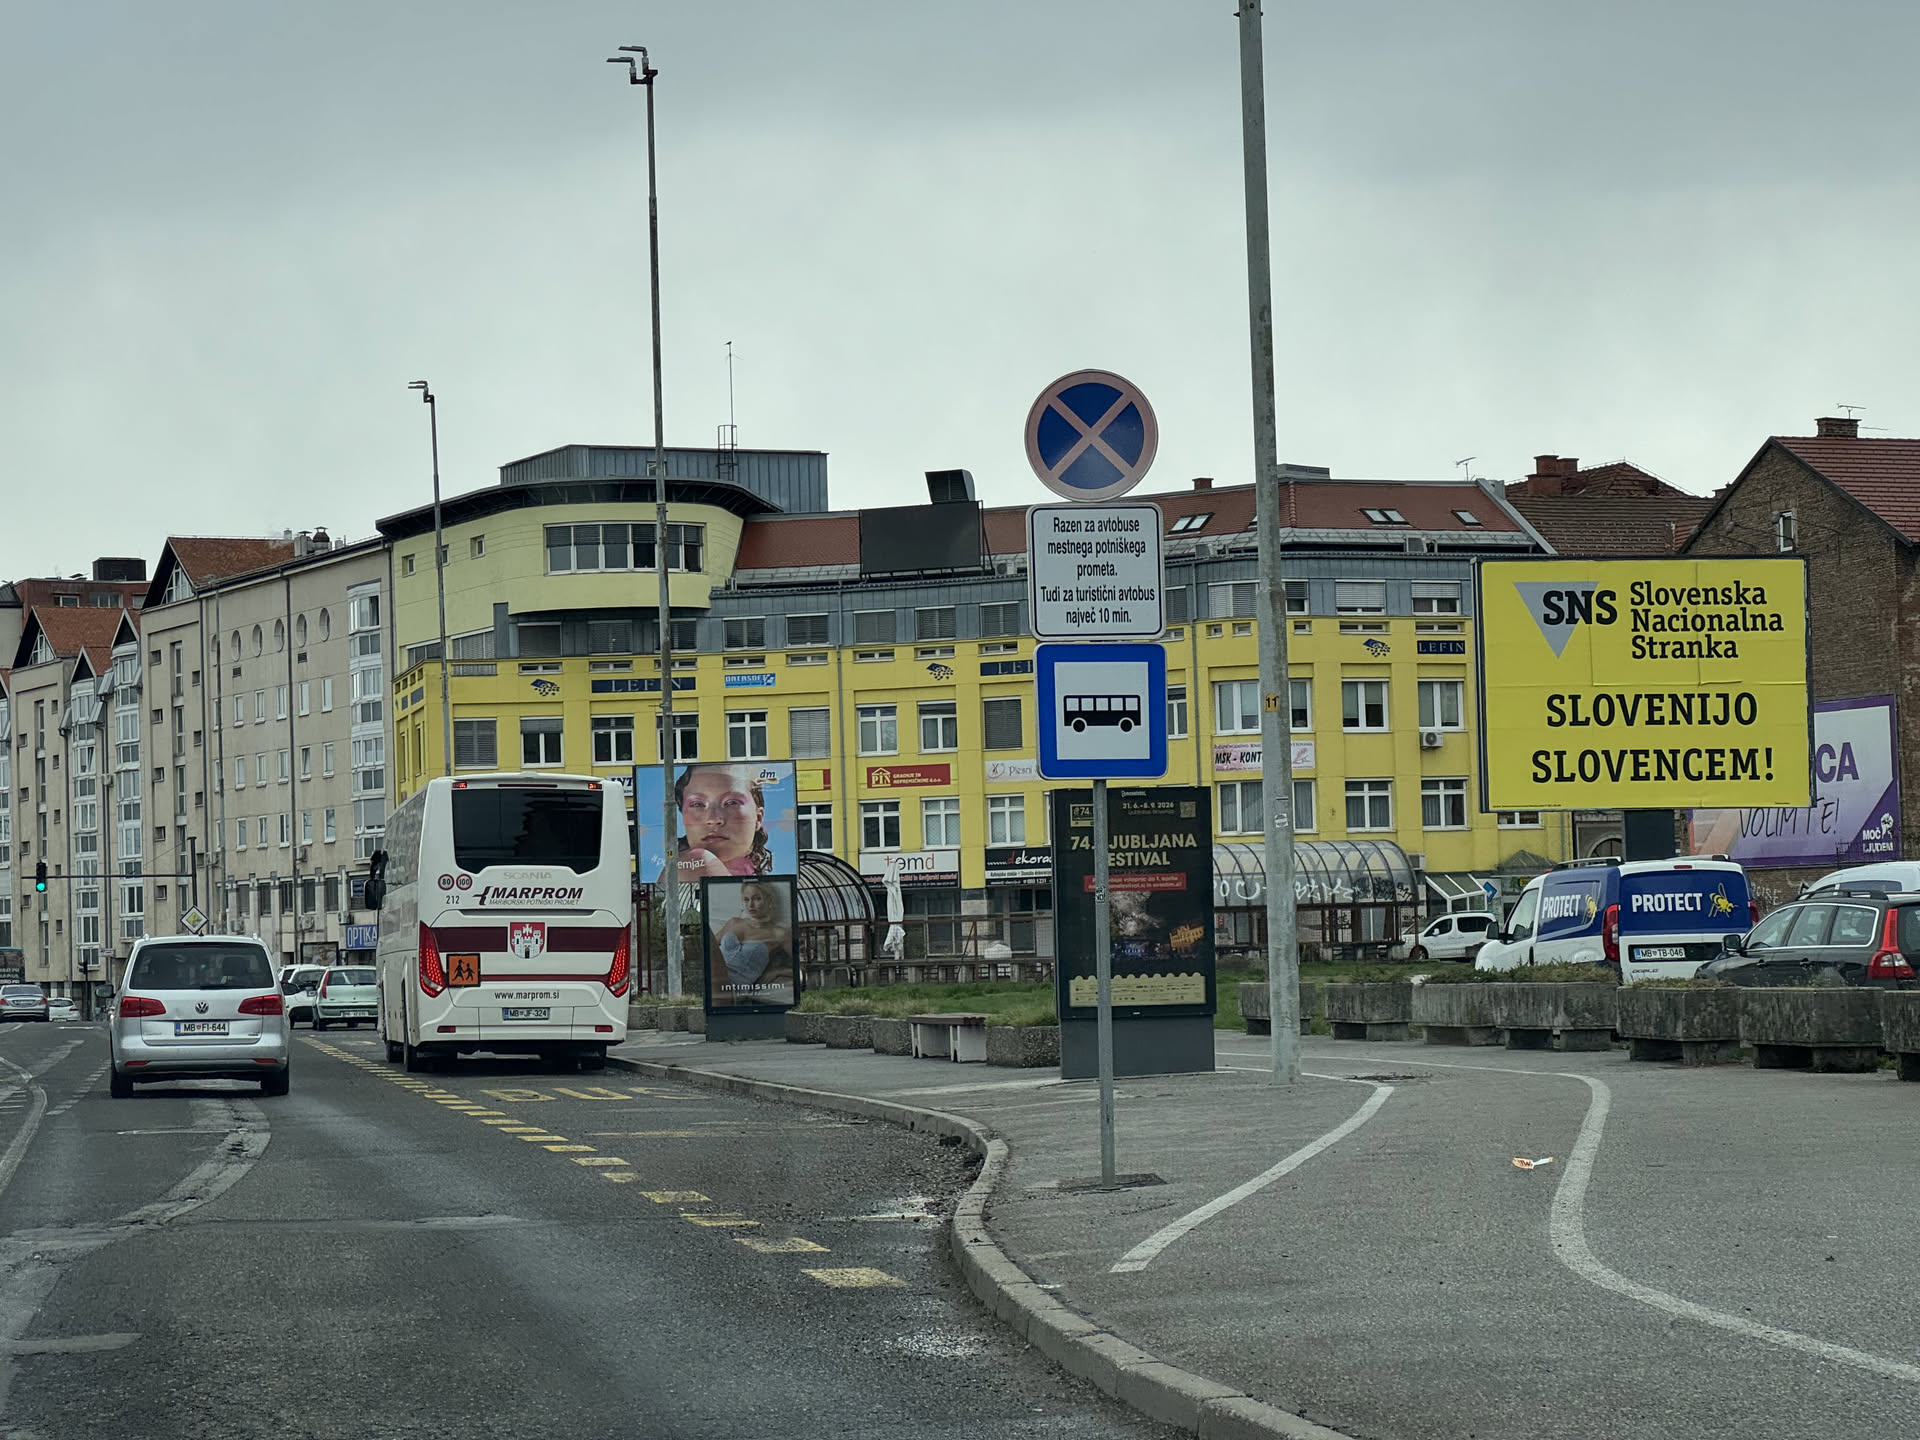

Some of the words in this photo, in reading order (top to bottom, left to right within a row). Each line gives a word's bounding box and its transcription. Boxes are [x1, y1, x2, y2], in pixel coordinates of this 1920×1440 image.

[1053, 517, 1082, 533] Razen
[1085, 521, 1095, 533] za
[1097, 516, 1140, 532] avtobuse
[1047, 539, 1093, 558] mestnega
[1095, 537, 1146, 558] potniškega
[1077, 561, 1118, 580] prometa.
[1040, 586, 1061, 602] Tudi
[1063, 589, 1073, 602] za
[1076, 584, 1116, 602] turistični
[1118, 585, 1155, 601] avtobus
[1630, 580, 1768, 607] Slovenska
[1542, 590, 1618, 626] SNS
[1066, 607, 1096, 628] največ
[1098, 607, 1110, 623] 10
[1112, 606, 1132, 623] min.
[1631, 607, 1785, 634] Nacionalna
[1419, 642, 1464, 652] LEFIN
[1631, 634, 1739, 660] Stranka
[611, 677, 683, 693] LEFN
[1265, 696, 1280, 708] 11
[1547, 692, 1758, 727] SLOVENIJO
[1215, 753, 1232, 764] MSK
[1532, 747, 1774, 783] SLOVENCEM!
[760, 769, 775, 779] dm
[1740, 807, 1796, 839] VOLIM
[1806, 798, 1841, 835] TE!
[1863, 827, 1881, 840] MOČ
[1071, 836, 1096, 850] 74.
[1108, 834, 1198, 849] JUBLJANA
[1863, 842, 1893, 853] LJUDEM
[1107, 852, 1170, 866] ESTIVAL
[442, 878, 451, 886] 80
[459, 878, 470, 886] 100
[503, 871, 552, 879] SCANIA
[446, 895, 460, 904] 212
[491, 887, 583, 899] MARPROM
[1541, 894, 1581, 919] PROTECT
[1632, 893, 1702, 912] PROTECT
[347, 926, 377, 947] OPTIKA
[1640, 949, 1653, 957] MB
[1657, 948, 1684, 957] TB-046
[494, 989, 560, 1001] www.marprom.si
[721, 983, 785, 991] intimissimi
[202, 1023, 226, 1031] FI-644
